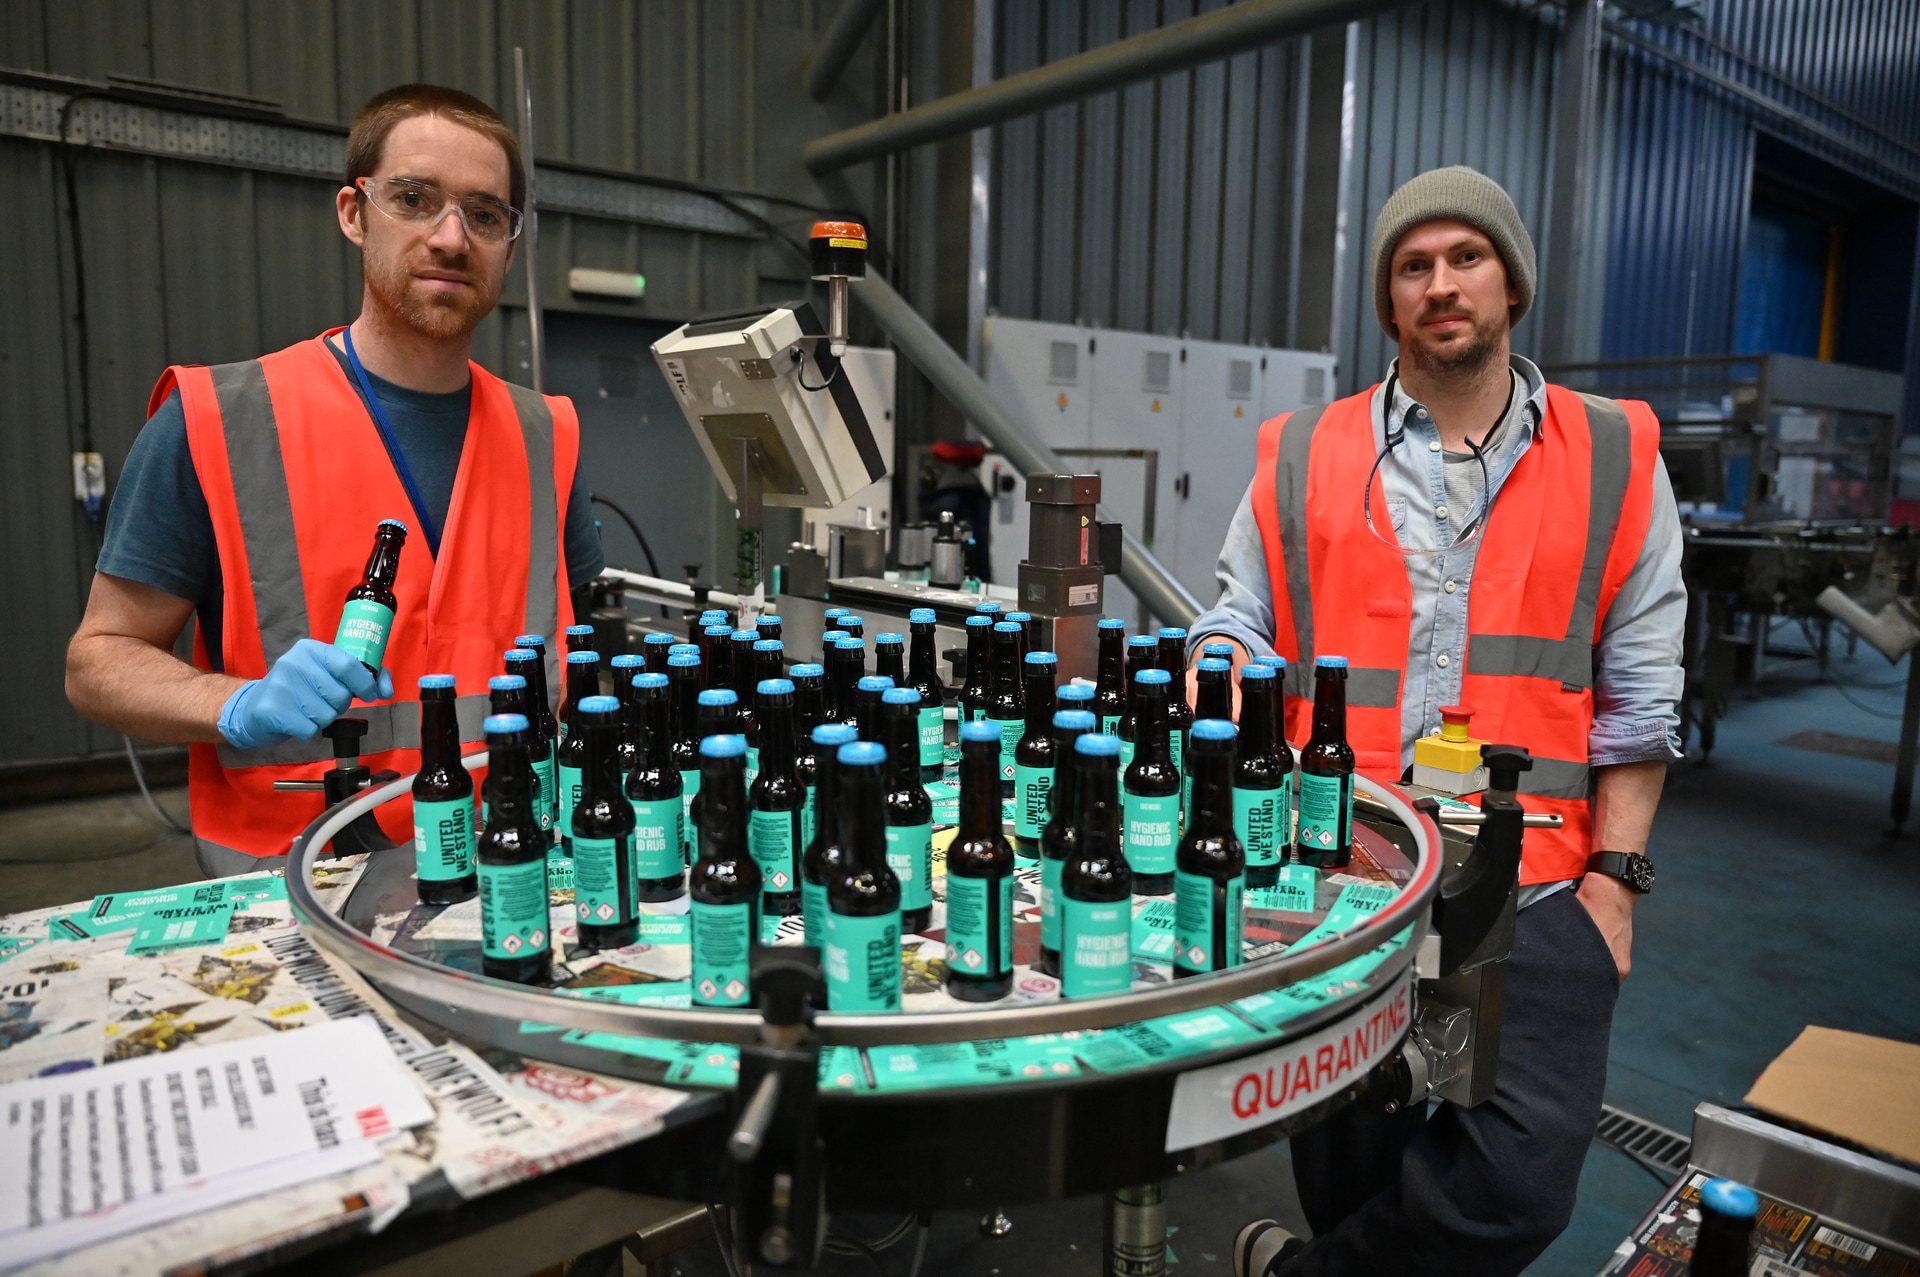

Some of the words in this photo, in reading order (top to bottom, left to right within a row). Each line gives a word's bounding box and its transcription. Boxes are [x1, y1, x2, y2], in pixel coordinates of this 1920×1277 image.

[342, 628, 365, 639] HAND
[365, 630, 381, 645] RUB
[345, 618, 384, 635] HYGIENIC
[921, 735, 939, 746] HAND
[1026, 783, 1039, 825] UNITED
[1037, 776, 1050, 814] STAND
[454, 807, 466, 850] STAND
[1130, 820, 1171, 834] HYGIENIC
[1247, 807, 1262, 852] UNITED
[1261, 798, 1275, 840] STAND
[439, 819, 456, 866] UNITED
[634, 825, 665, 839] GIENIC
[1129, 833, 1153, 847] HAND
[1153, 833, 1172, 847] RUB
[647, 838, 666, 851] RUB
[1260, 841, 1273, 861] WE
[455, 850, 467, 873] WE
[867, 940, 884, 1001] UNITED
[1231, 984, 1408, 1120] QUARANTINE
